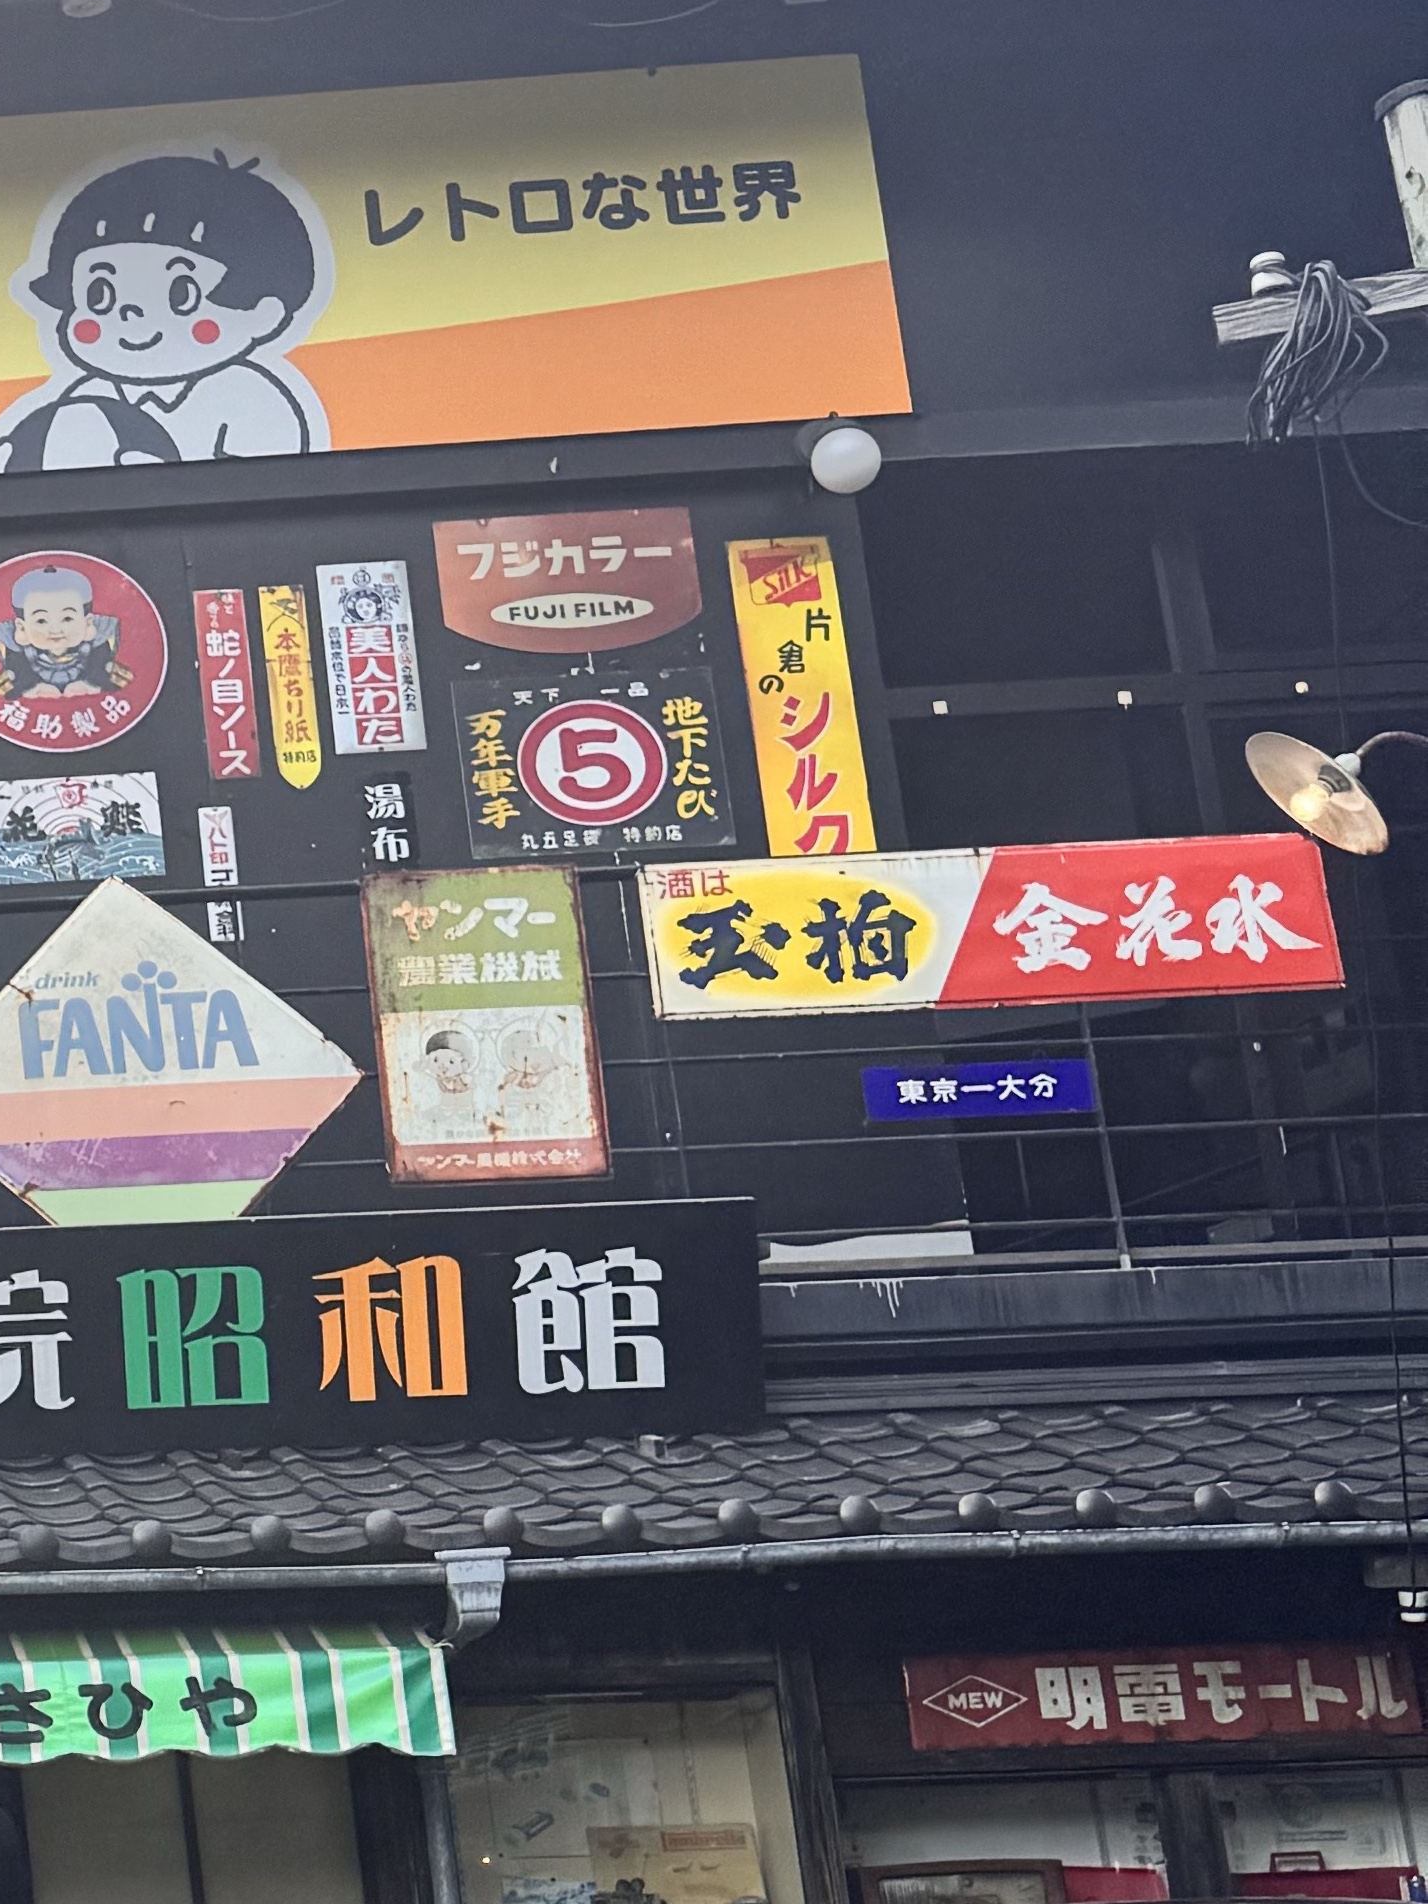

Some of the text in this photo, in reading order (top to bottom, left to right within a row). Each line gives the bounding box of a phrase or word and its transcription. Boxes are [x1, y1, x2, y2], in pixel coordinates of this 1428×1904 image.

[365, 161, 804, 248] レトロな世界
[456, 534, 673, 581] フジカラー
[509, 599, 635, 622] FUJI FILM
[205, 629, 251, 776] 蛇ノ目ソース
[349, 625, 402, 746] 美人わた
[465, 708, 520, 829] 万年軍手
[662, 696, 718, 819] 地下たび
[780, 690, 850, 854] シルク
[364, 783, 410, 863] 湯布
[393, 898, 556, 941] ヤンマー
[659, 870, 733, 900] 酒は
[35, 969, 101, 991] drink
[398, 950, 562, 986] 農業機械
[18, 976, 260, 1080] FANTA
[947, 1692, 1004, 1711] MEW
[1034, 1652, 1409, 1730] 明電モートル
